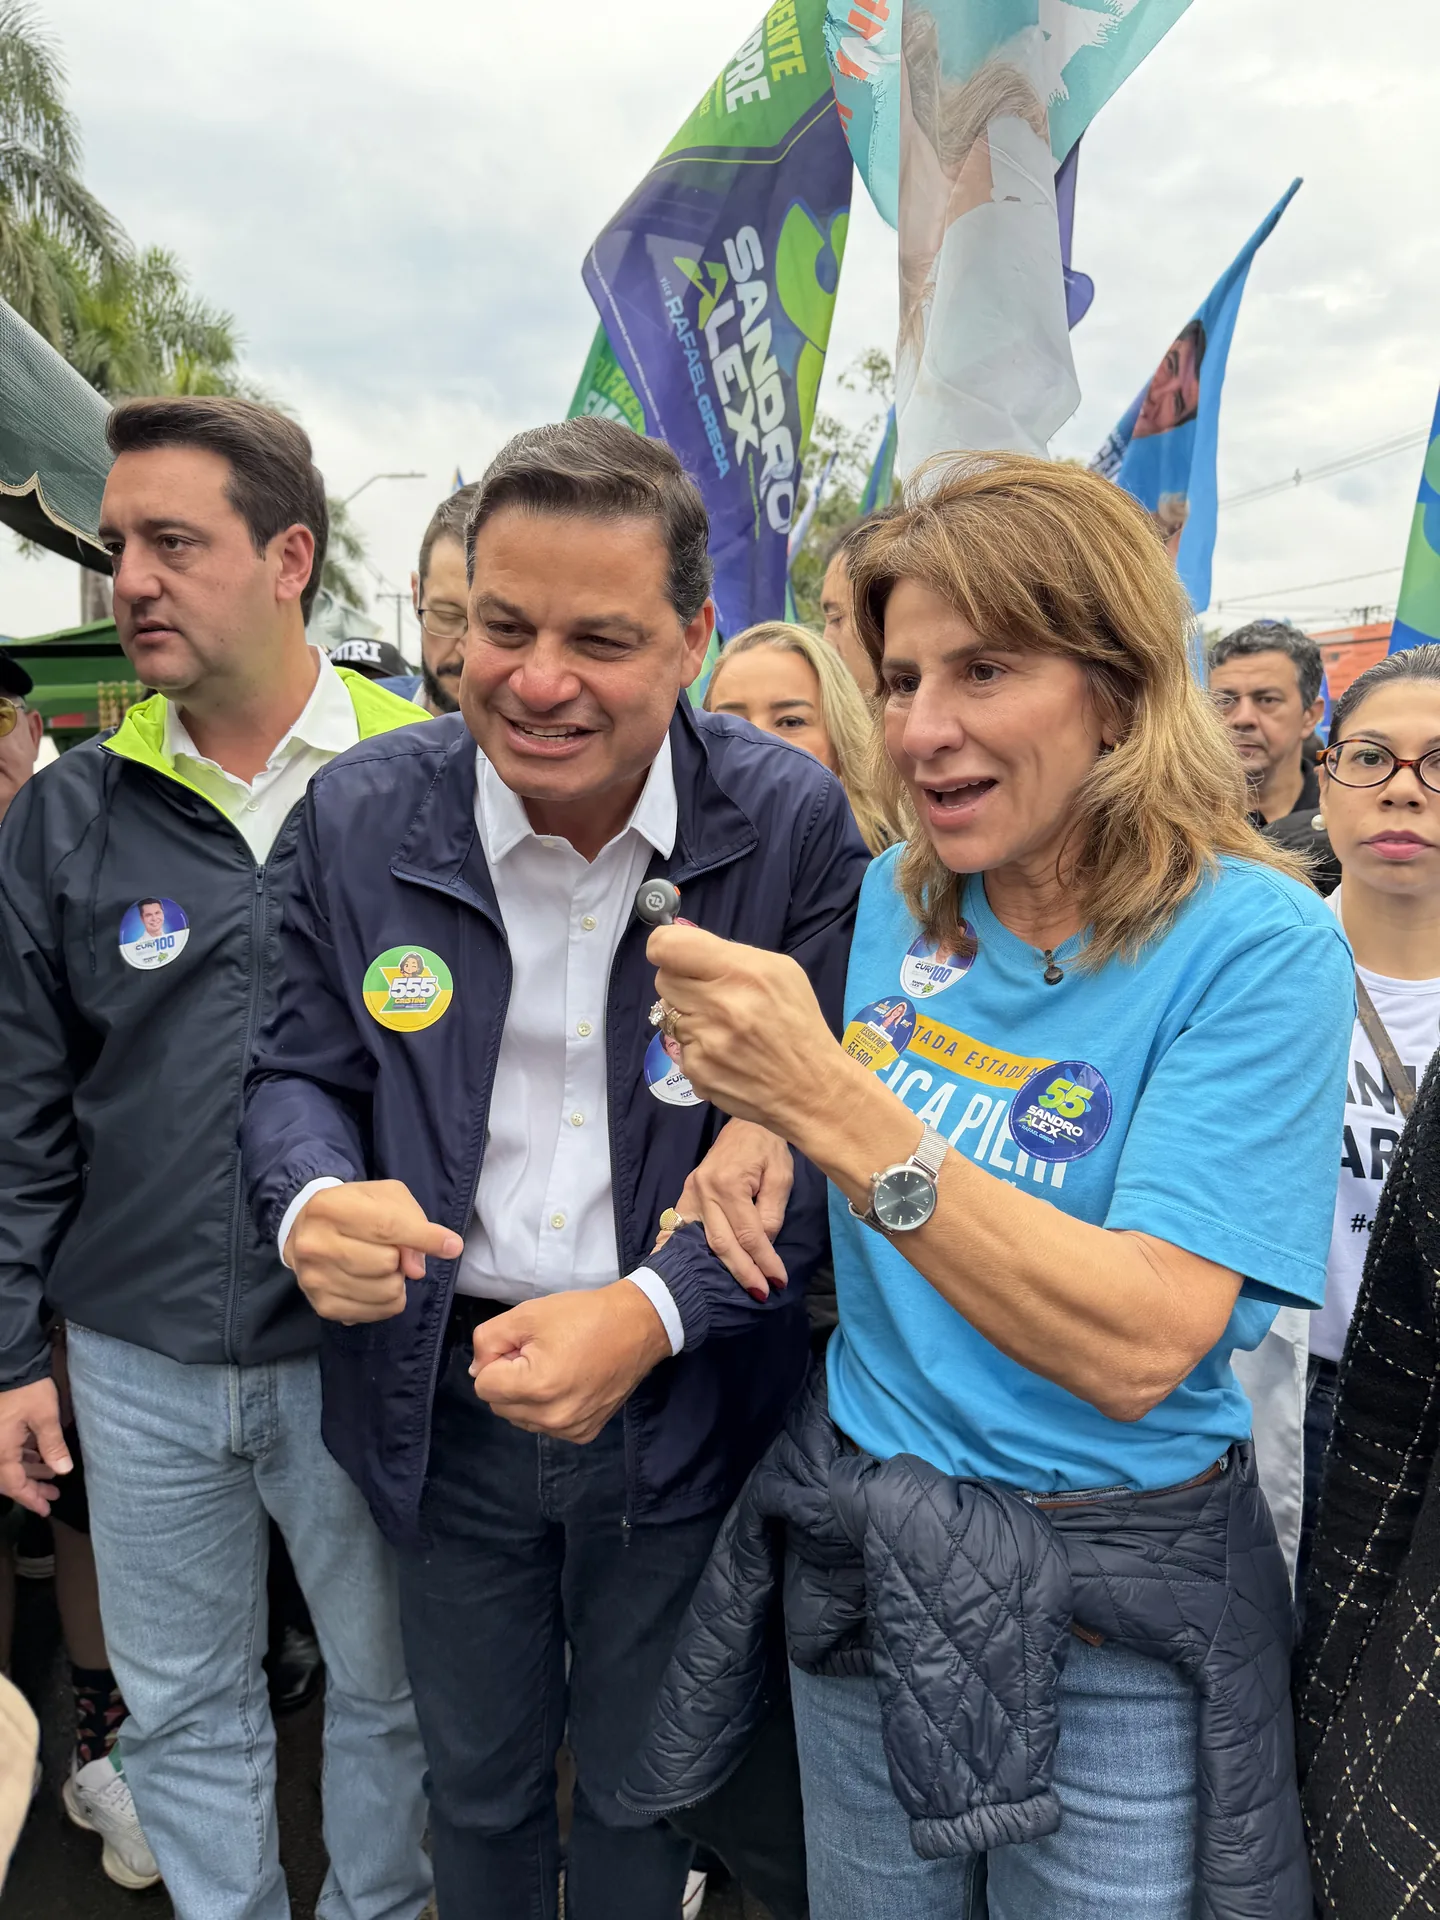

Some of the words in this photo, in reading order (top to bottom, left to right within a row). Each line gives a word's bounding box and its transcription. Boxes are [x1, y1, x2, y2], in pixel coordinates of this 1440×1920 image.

[726, 19, 771, 114] PRE
[664, 295, 707, 397] RAFAEL
[698, 393, 731, 480] GRECA
[723, 225, 794, 535] SANDRO
[154, 935, 175, 951] 100
[390, 977, 437, 999] 555
[915, 962, 934, 973] CURI
[929, 965, 952, 983] 100
[874, 1060, 958, 1133] ICA
[1038, 1077, 1095, 1119] 55
[1019, 1113, 1062, 1139] ALEX
[1021, 1124, 1039, 1137] RAFAEL
[1026, 1104, 1084, 1138] SANDRO
